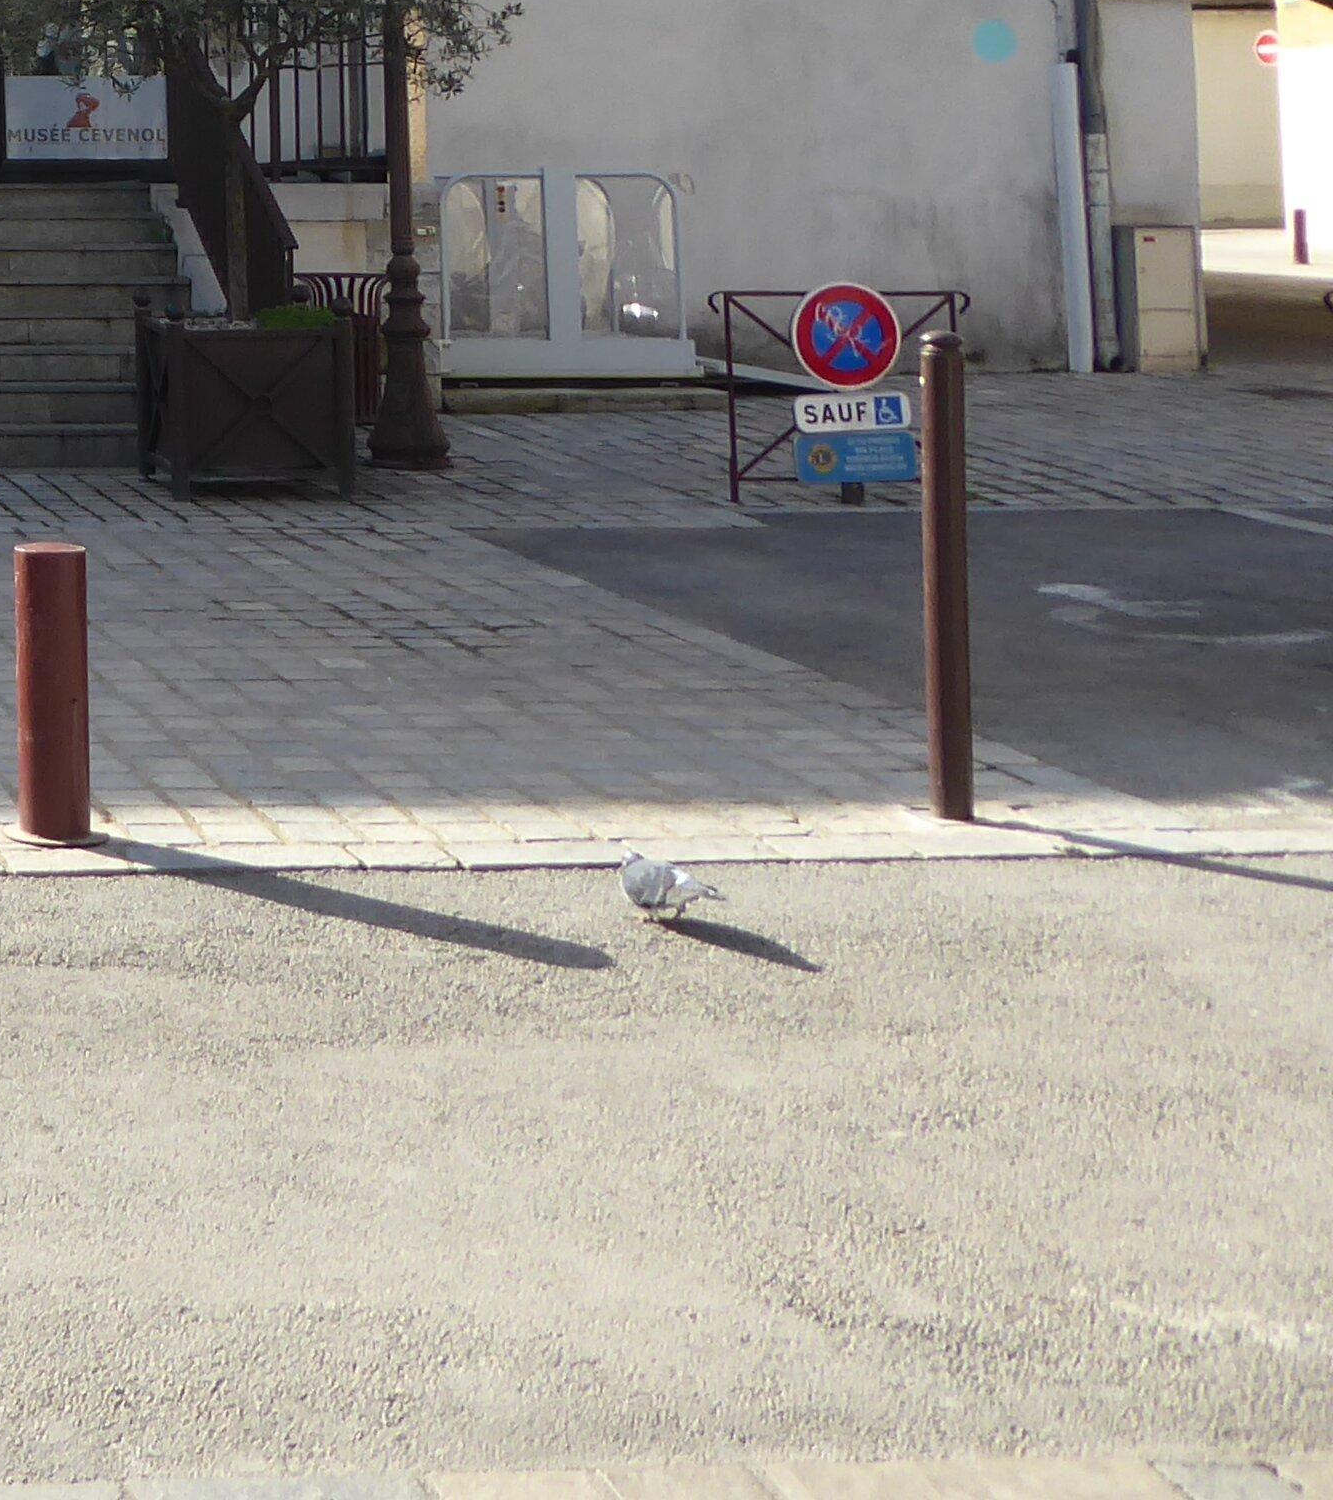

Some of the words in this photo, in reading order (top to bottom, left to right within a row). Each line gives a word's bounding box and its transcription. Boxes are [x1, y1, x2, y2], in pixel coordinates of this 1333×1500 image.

[8, 123, 71, 142] MUSÉE
[78, 123, 166, 142] CÉVENOL
[803, 401, 869, 424] SAUF
